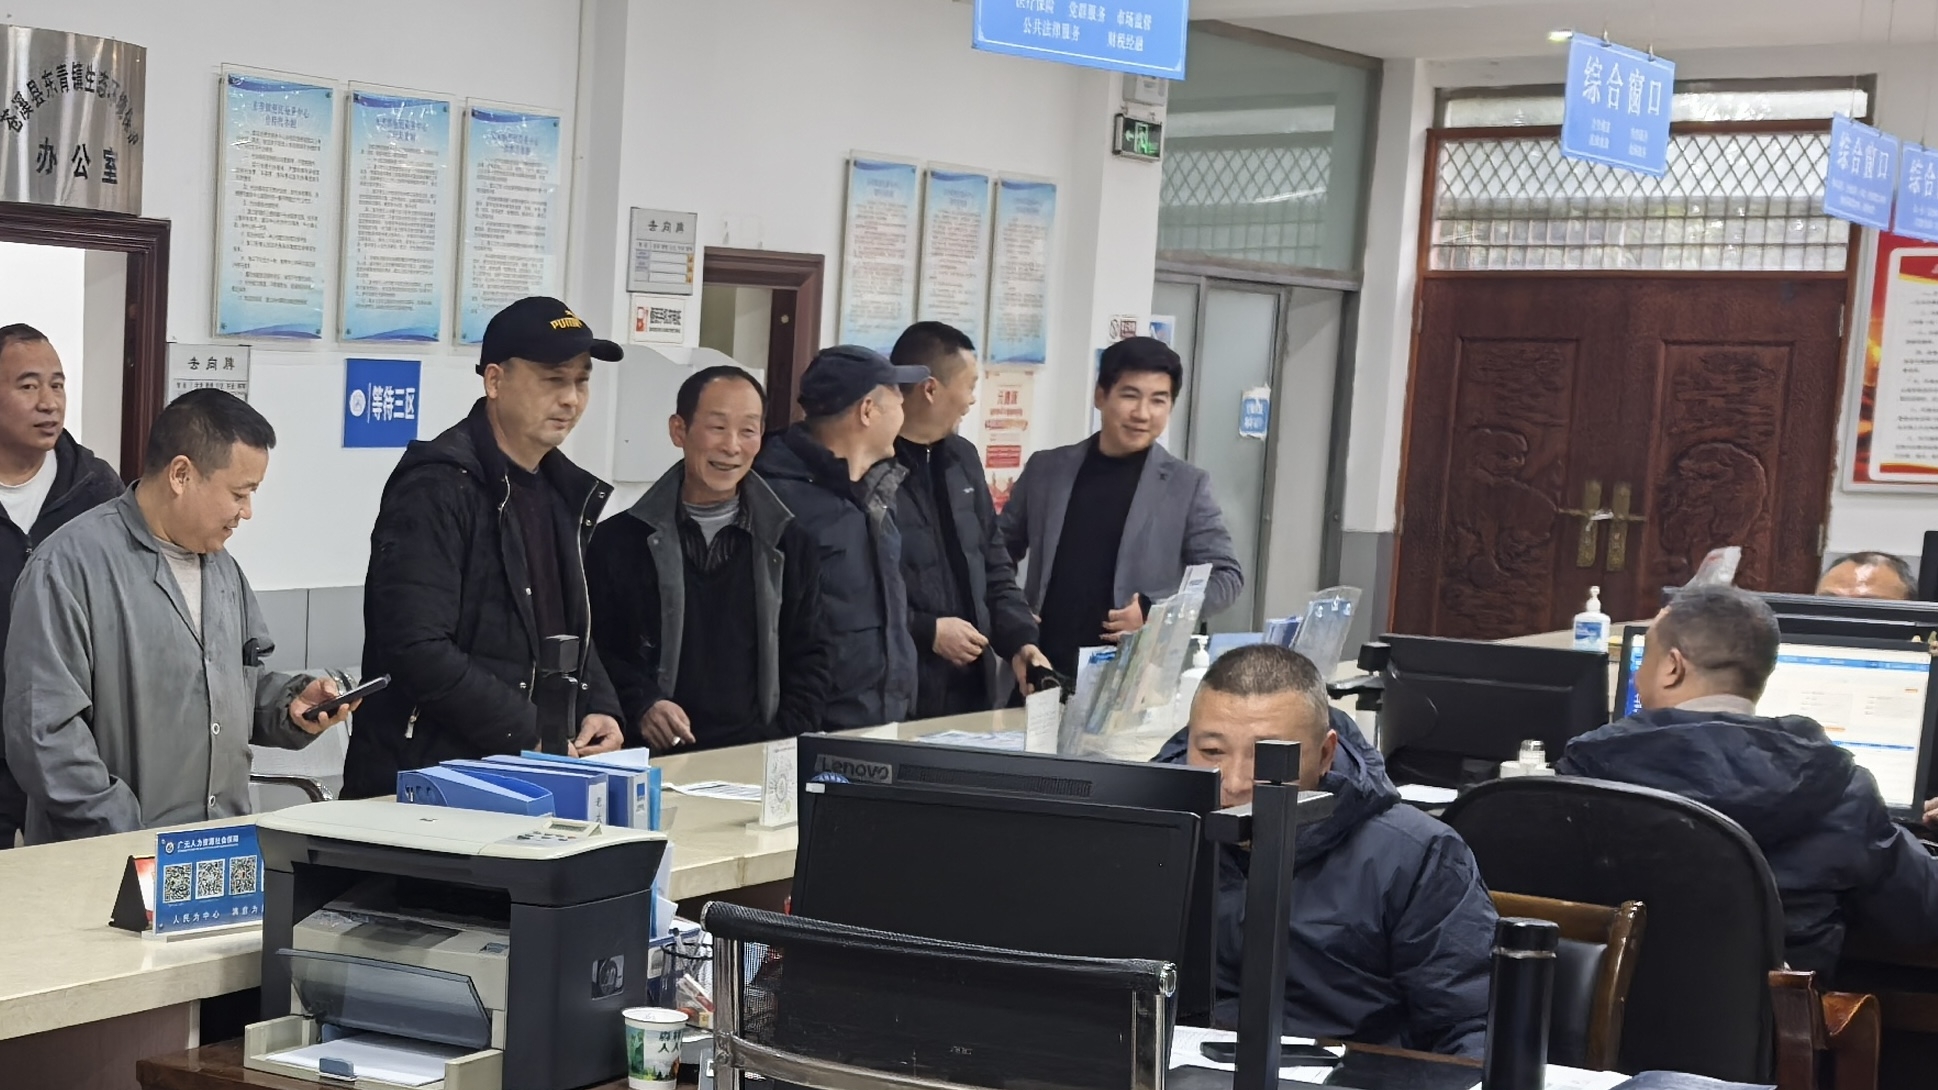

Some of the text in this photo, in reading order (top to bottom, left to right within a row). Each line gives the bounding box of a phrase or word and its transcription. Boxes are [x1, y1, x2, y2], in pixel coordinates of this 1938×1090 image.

[1023, 16, 1080, 42] 公共法律服务
[1069, 1, 1106, 23] 党群服务
[1117, 8, 1152, 31] 市场监管
[1582, 55, 1662, 117] 综合窗口
[36, 137, 118, 185] 办公室
[1837, 131, 1890, 180] 综合窗口
[187, 356, 235, 370] 去向牌
[372, 386, 416, 421] 等待三区
[822, 757, 889, 780] Lenovo
[177, 834, 239, 850] 广元人力资源社会保障
[173, 909, 221, 925] 人民为中心
